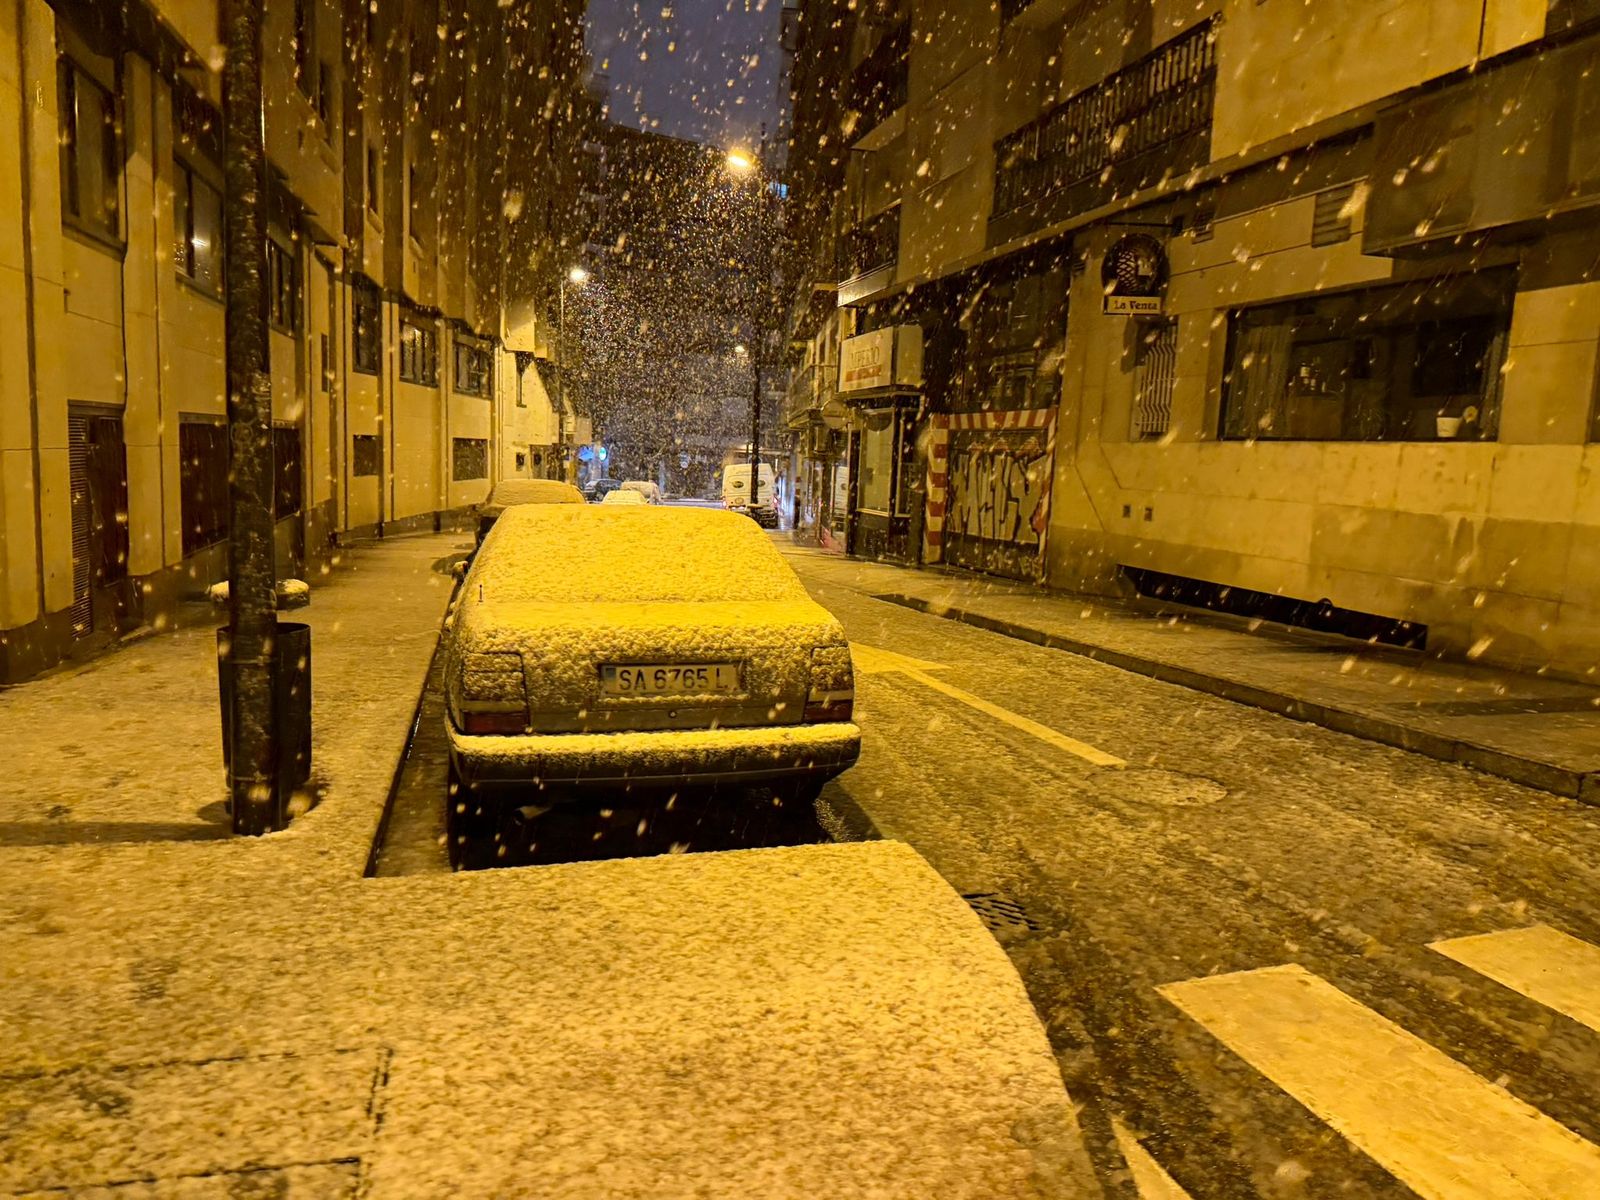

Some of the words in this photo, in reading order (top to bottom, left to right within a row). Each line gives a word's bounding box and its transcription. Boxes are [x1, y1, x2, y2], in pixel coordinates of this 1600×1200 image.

[1114, 300, 1126, 309] La
[1129, 300, 1157, 310] Venta
[619, 669, 646, 690] SA
[653, 668, 708, 690] 6765
